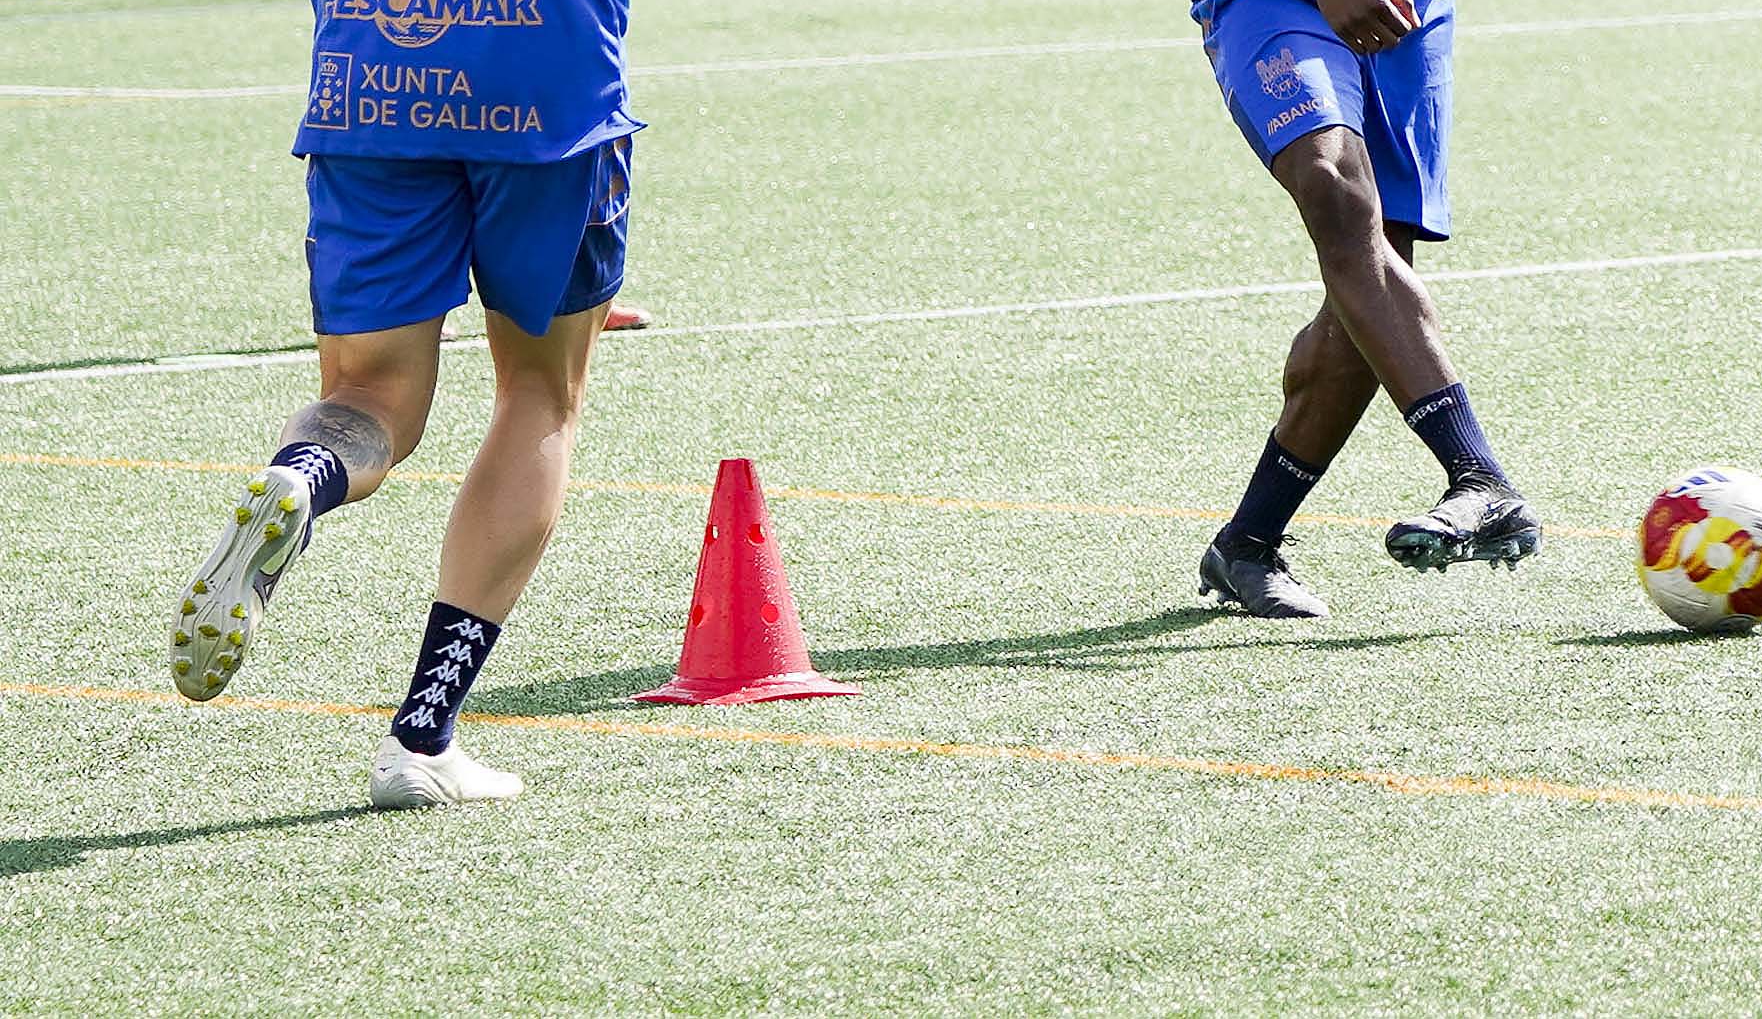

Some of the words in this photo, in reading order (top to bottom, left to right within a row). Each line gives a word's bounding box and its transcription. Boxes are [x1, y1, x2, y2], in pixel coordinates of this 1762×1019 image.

[359, 63, 473, 97] XUNTA
[358, 97, 399, 126] DE
[409, 100, 543, 133] GALICIA
